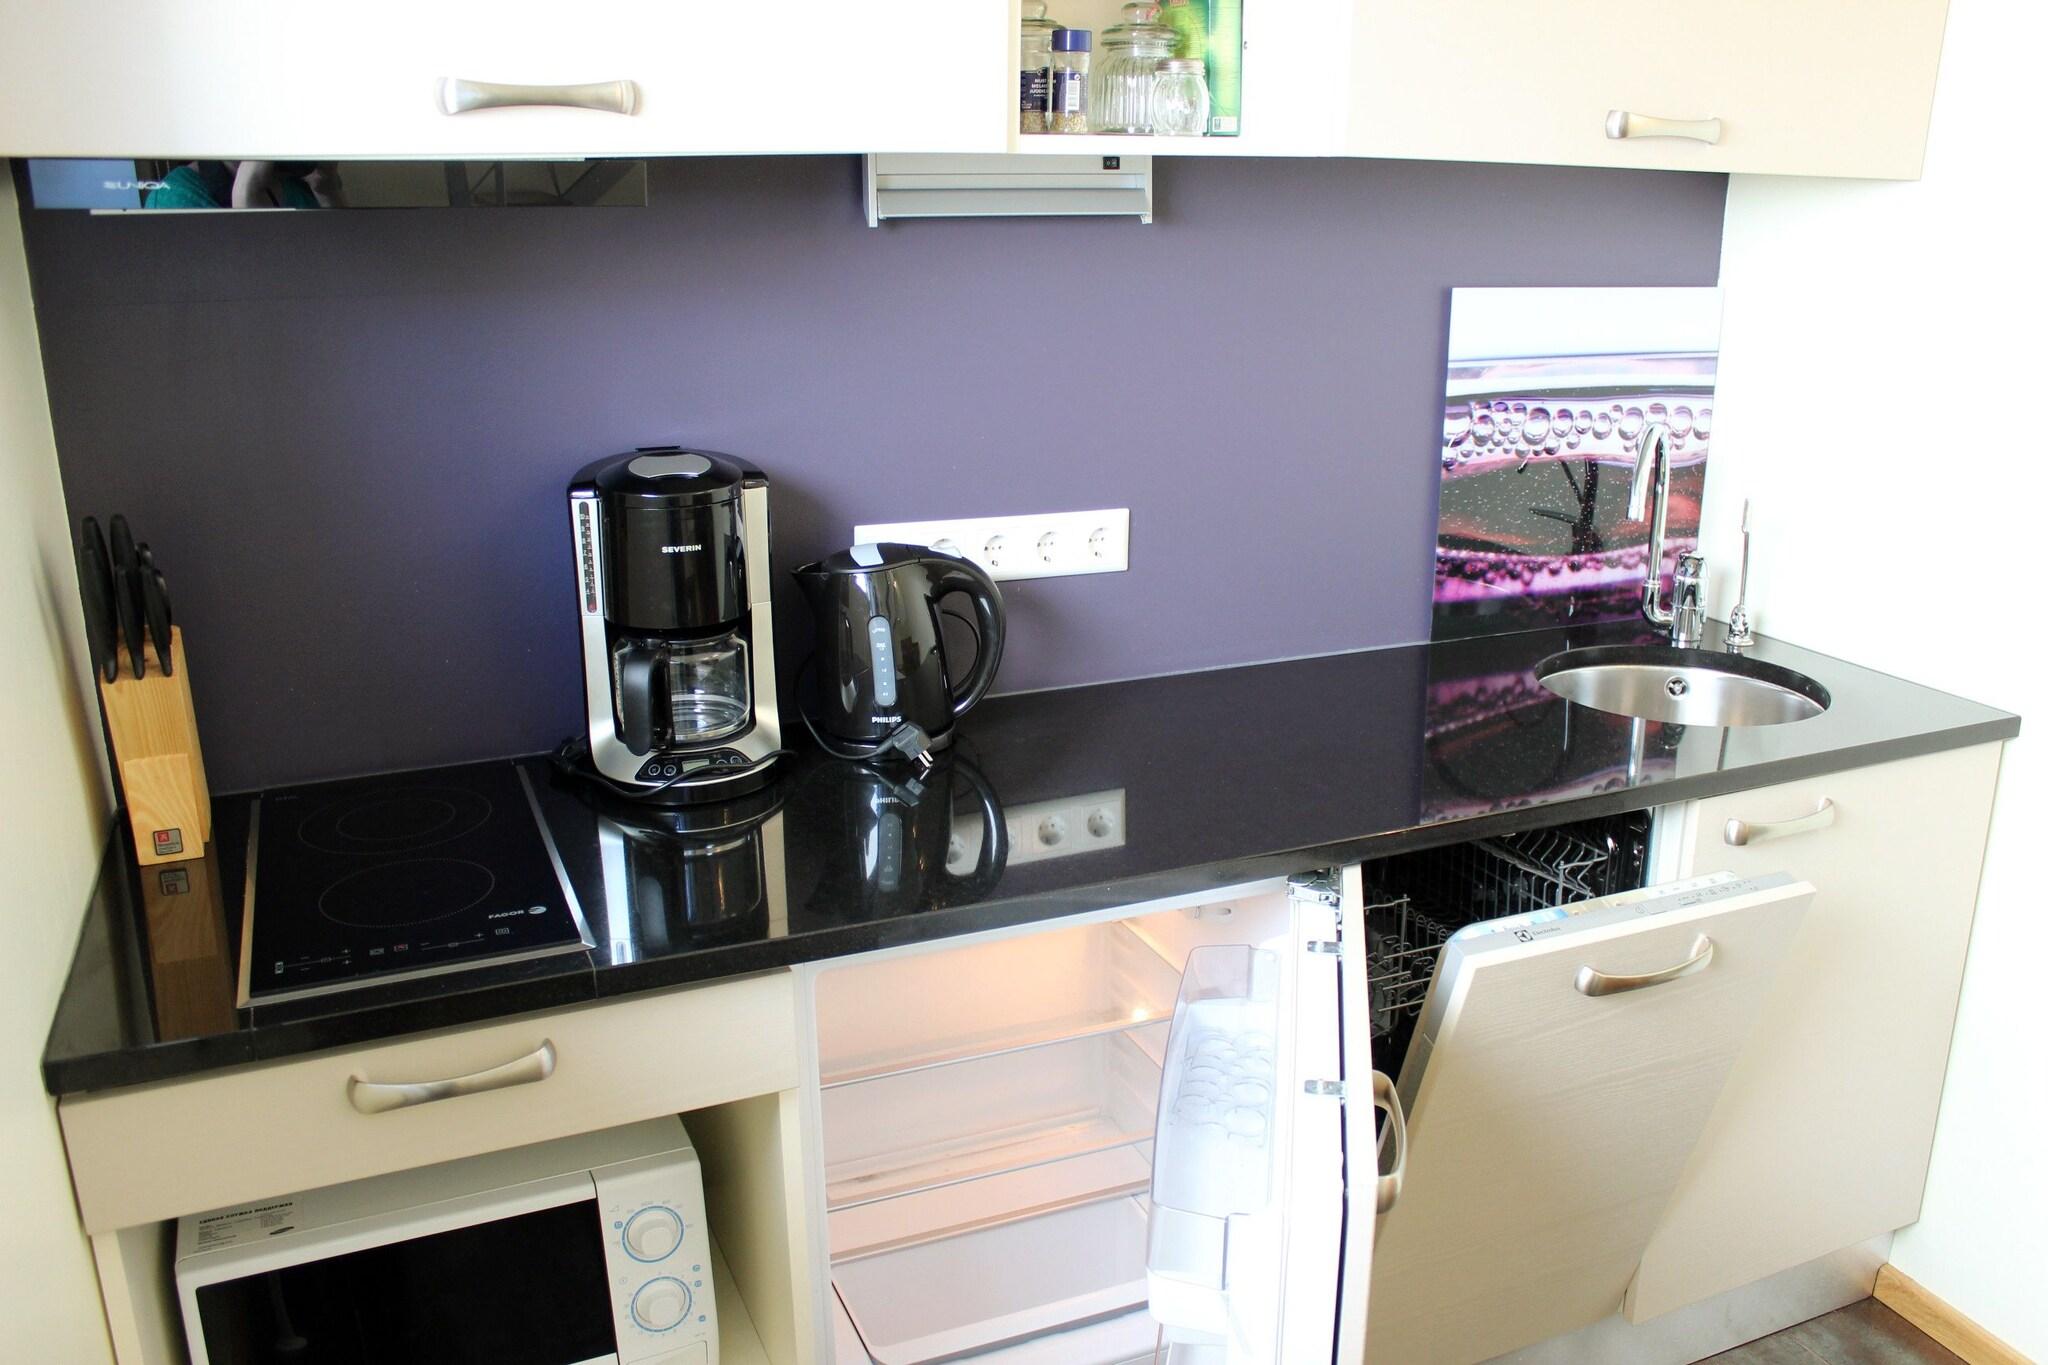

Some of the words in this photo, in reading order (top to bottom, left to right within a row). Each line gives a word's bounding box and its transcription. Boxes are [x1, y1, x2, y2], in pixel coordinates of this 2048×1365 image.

[661, 544, 702, 554] SEVERIN
[871, 716, 902, 724] PHILIPS
[488, 910, 525, 919] FAGOR
